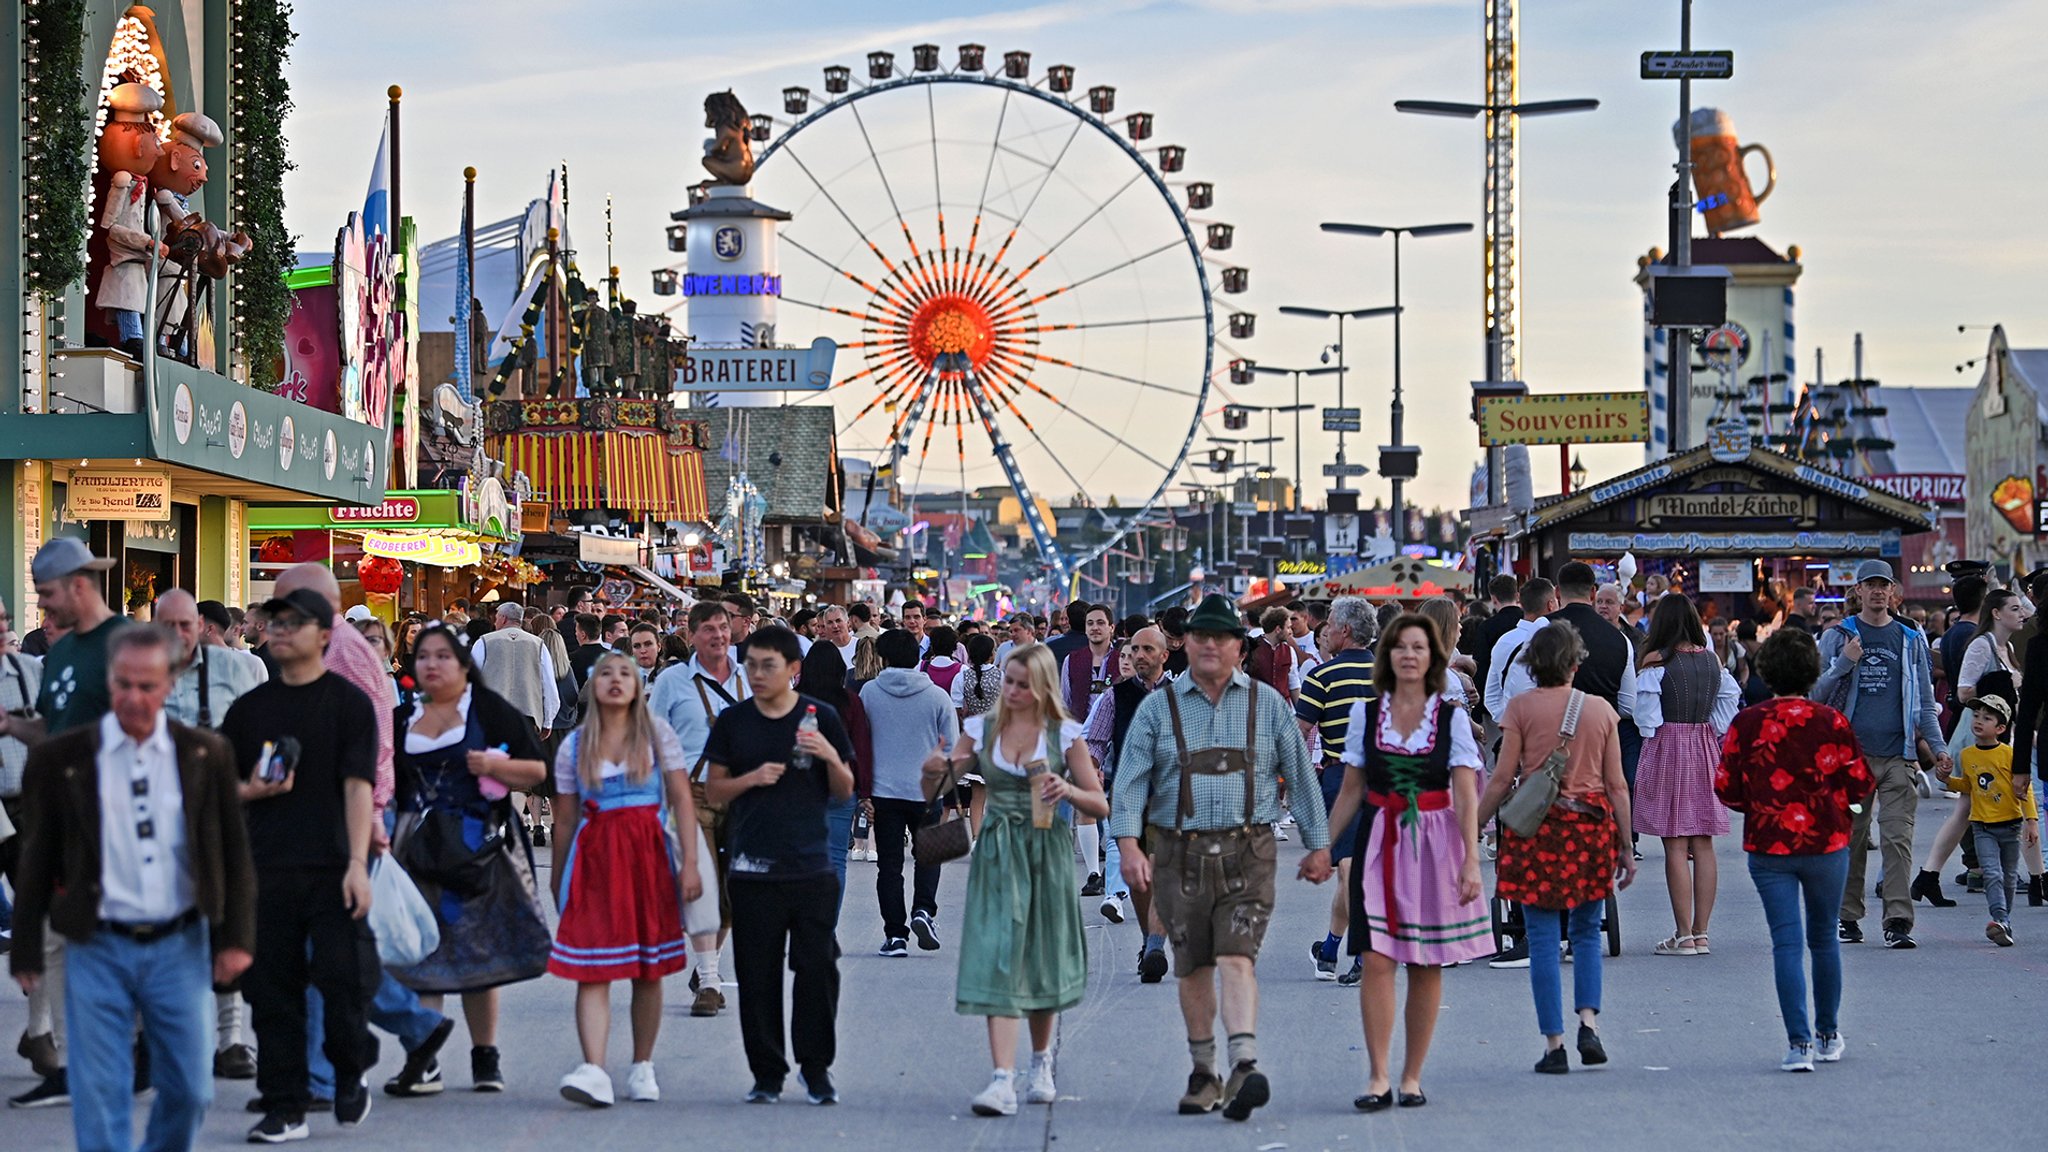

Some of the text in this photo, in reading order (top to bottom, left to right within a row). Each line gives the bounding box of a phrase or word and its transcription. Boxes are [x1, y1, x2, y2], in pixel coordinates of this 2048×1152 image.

[1500, 408, 1628, 432] Souvenirs
[1594, 467, 1665, 501] Gebrannte
[1801, 465, 1862, 498] Mandeln
[102, 497, 134, 508] Hendl
[1658, 496, 1799, 517] Mandel-Küche
[367, 537, 427, 552] ERDBEEREN
